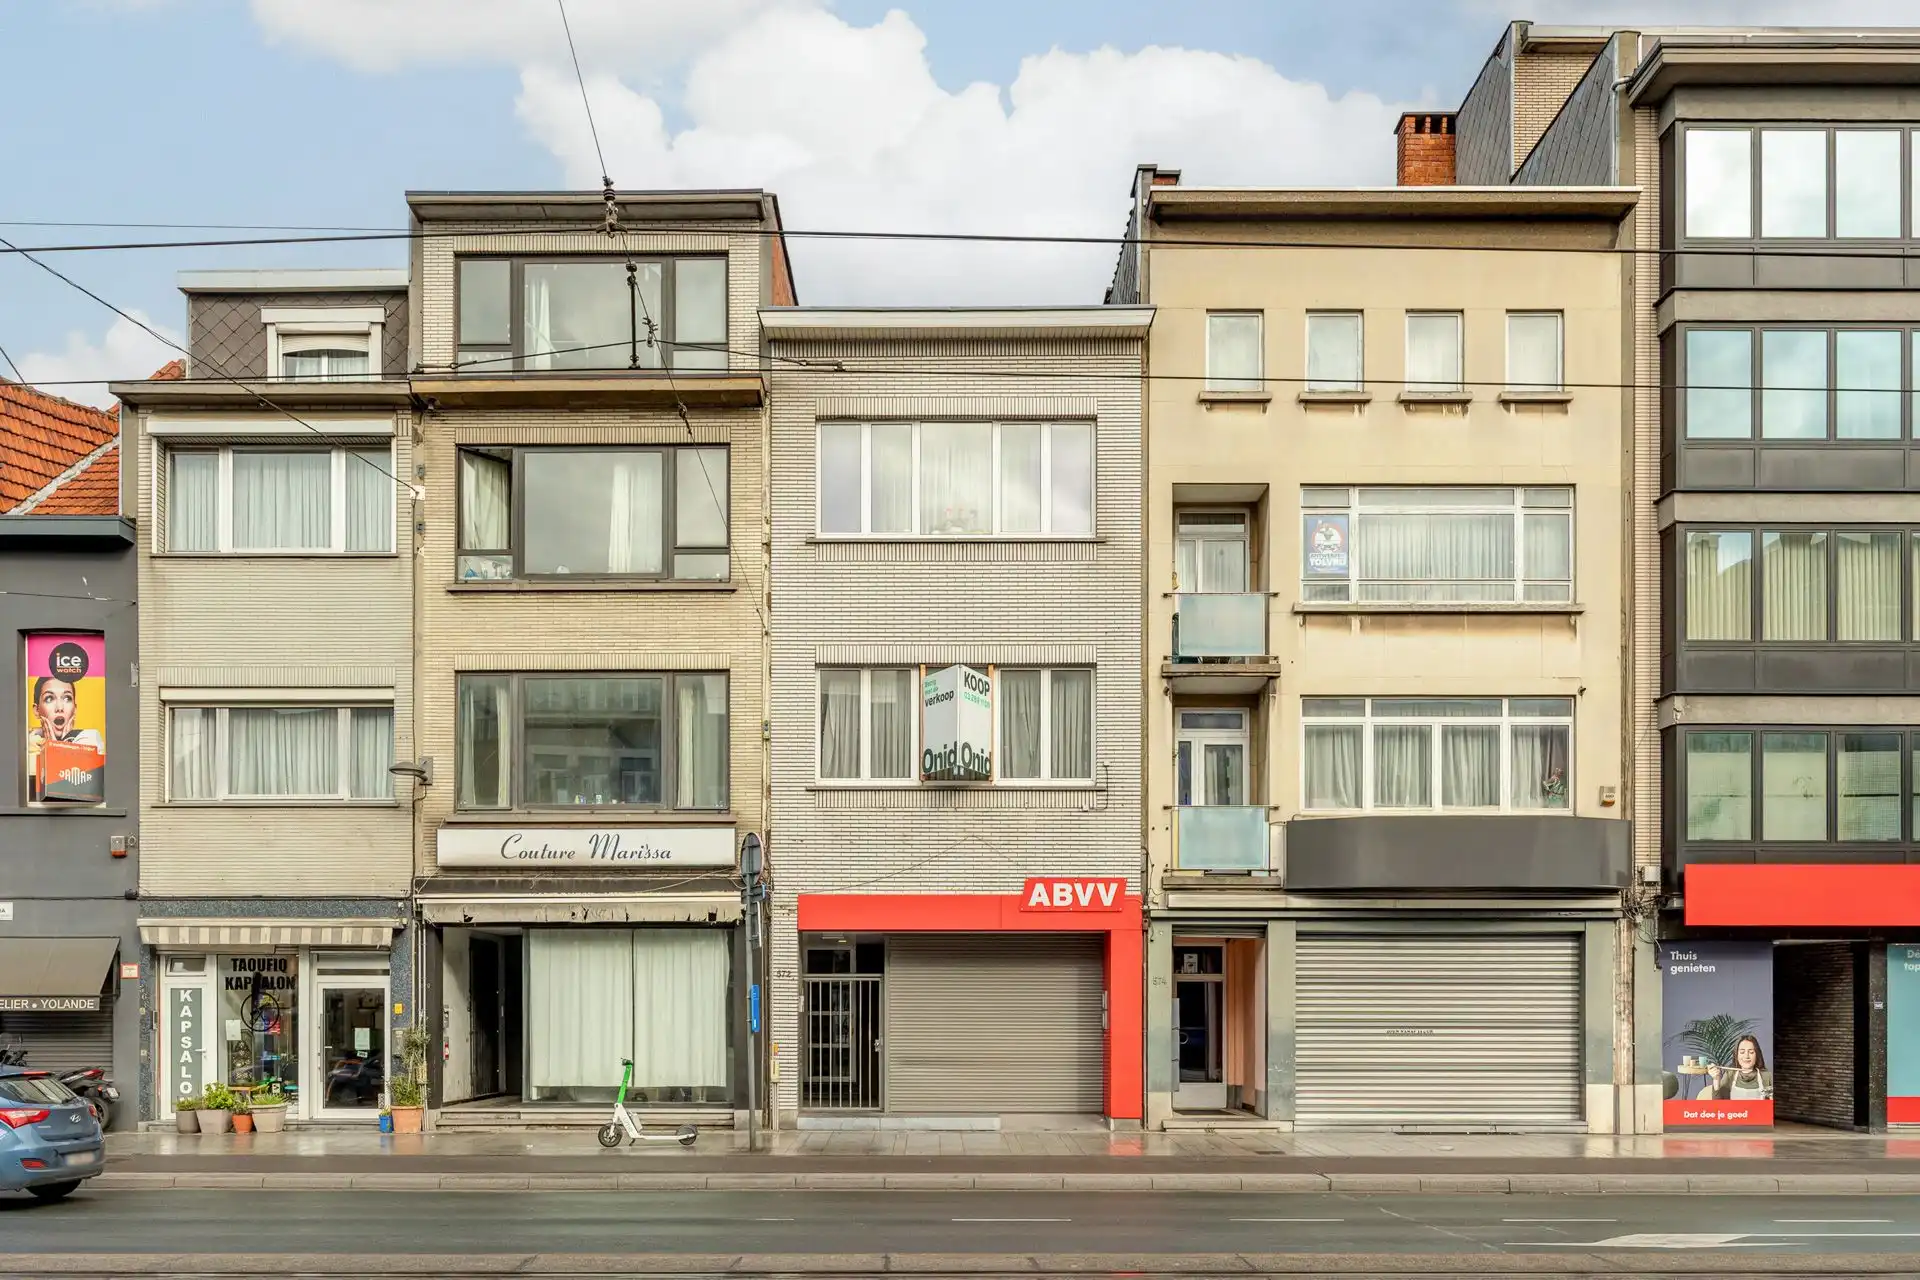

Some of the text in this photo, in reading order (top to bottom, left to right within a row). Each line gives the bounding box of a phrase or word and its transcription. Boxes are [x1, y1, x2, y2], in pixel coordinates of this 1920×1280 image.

[56, 652, 82, 667] ice
[964, 671, 990, 696] KOOP
[924, 690, 955, 707] verkoop
[922, 740, 958, 774] Onid
[500, 833, 576, 860] Couture
[1027, 882, 1119, 907] ABVV
[1669, 950, 1698, 961] Thuis
[231, 957, 288, 973] TAOUFIQ
[1669, 962, 1716, 975] genieten
[225, 975, 297, 990] KAPALON
[40, 999, 94, 1009] YOLANDE
[179, 989, 193, 1101] KAPSALO
[1683, 1110, 1698, 1118] Dat
[1717, 1110, 1725, 1120] je
[1727, 1109, 1748, 1120] goed
